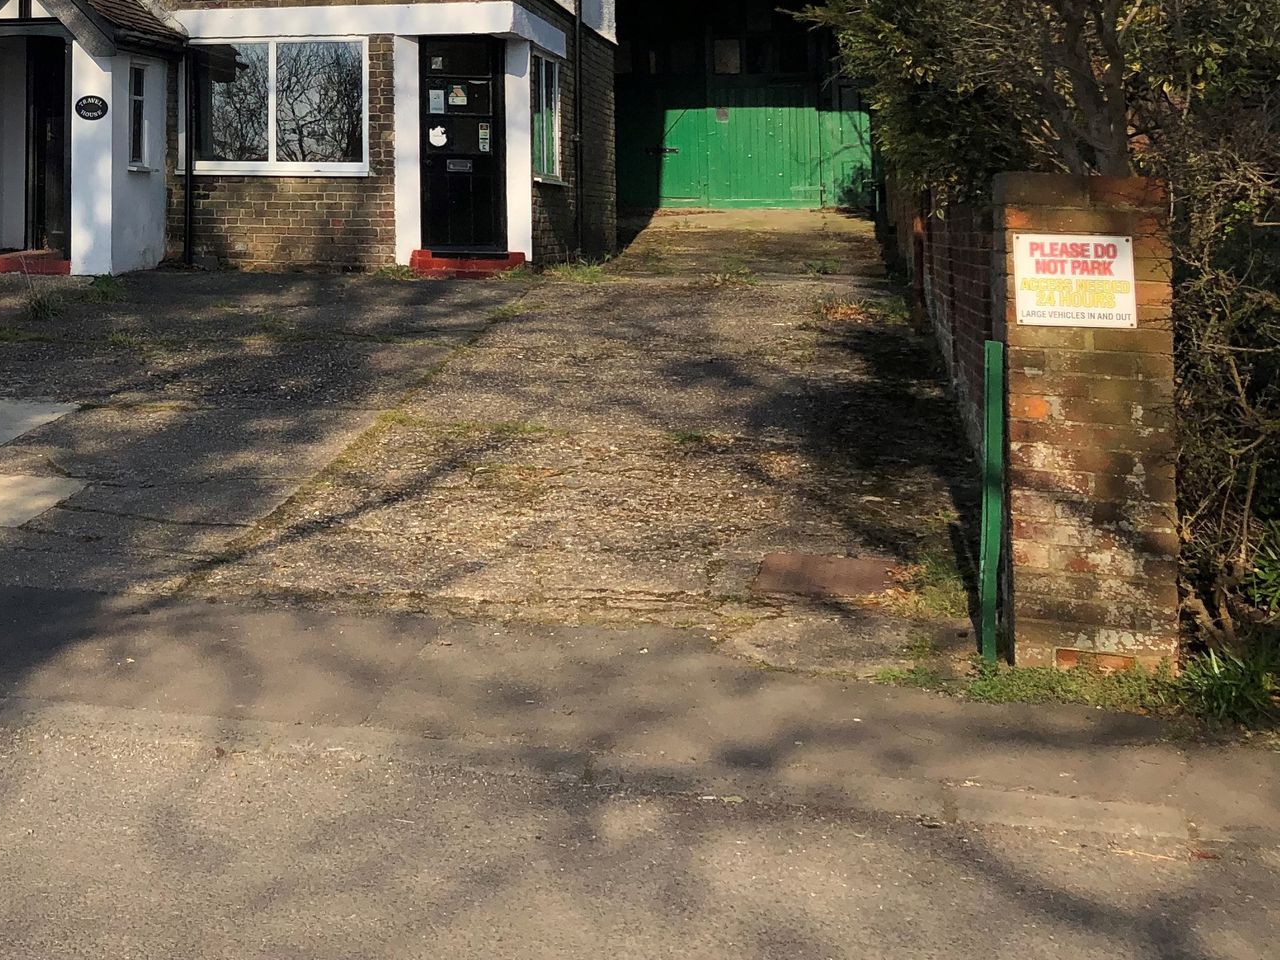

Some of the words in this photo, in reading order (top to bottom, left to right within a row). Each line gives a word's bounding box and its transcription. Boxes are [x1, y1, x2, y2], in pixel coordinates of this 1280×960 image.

[78, 97, 103, 107] TRAVEL
[80, 109, 102, 117] HOUSE
[1029, 242, 1090, 258] PLEASE
[1094, 243, 1117, 259] DO
[1035, 259, 1068, 275] NOT
[1071, 260, 1114, 276] PARK
[1021, 278, 1073, 291] ACCESS
[1075, 279, 1131, 294] NEEDED
[1035, 290, 1056, 307] 24
[1060, 292, 1116, 308] HOURS
[1021, 310, 1047, 319] LARGE
[1048, 310, 1086, 320] VEHICLES
[1087, 311, 1096, 320] IN
[1097, 311, 1114, 321] AND
[1115, 313, 1131, 321] OUT
